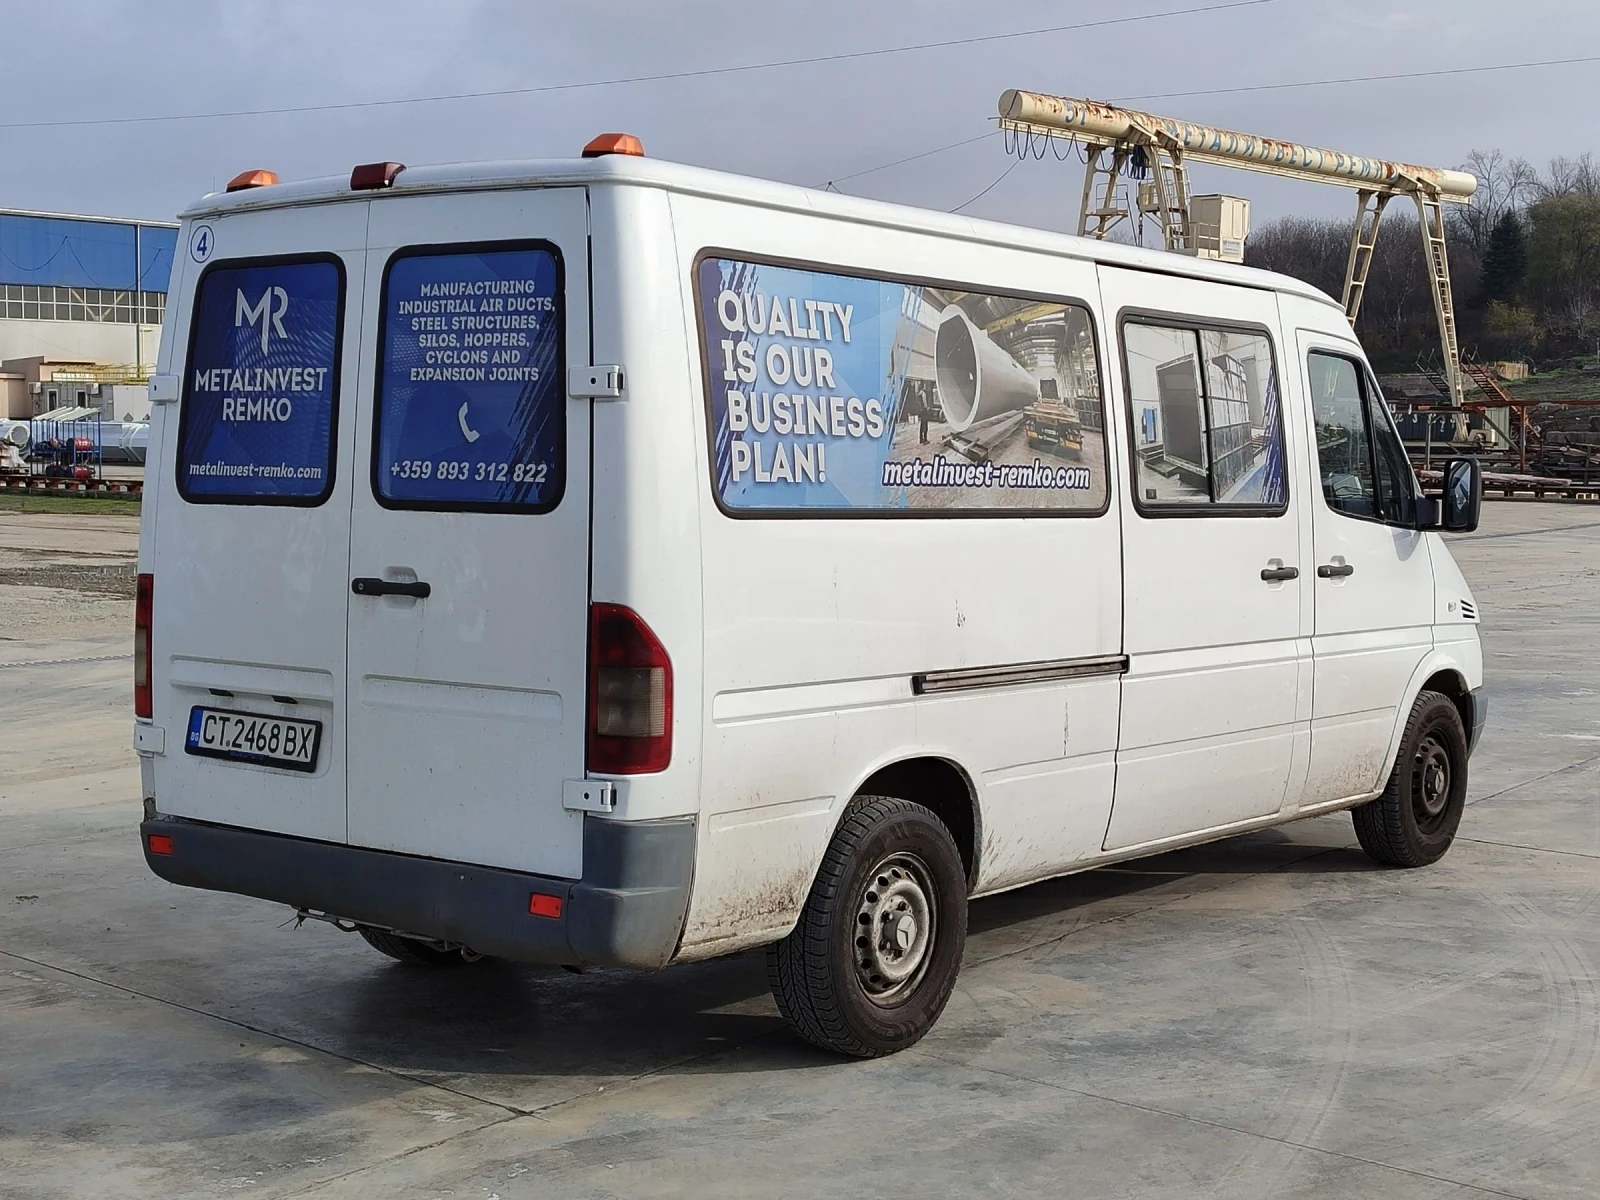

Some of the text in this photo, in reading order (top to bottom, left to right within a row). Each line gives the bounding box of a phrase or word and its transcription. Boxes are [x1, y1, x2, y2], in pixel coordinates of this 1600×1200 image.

[196, 231, 208, 256] 4
[420, 280, 535, 297] MANUFACTURING
[399, 297, 555, 314] INDUSTRIAL AIR DUCTS,
[717, 289, 854, 342] QUALITY
[411, 315, 540, 331] STEEL STRUCTURES,
[418, 332, 530, 348] SILOS, HOPPERS,
[426, 350, 520, 364] CYCLONS AND
[721, 339, 837, 388] IS OUR
[195, 367, 327, 392] METALINVEST
[410, 367, 539, 381] EXPANSION JOINTS
[222, 397, 292, 422] REMKO
[727, 389, 884, 438] BUSINESS
[189, 461, 321, 479] metalinvest-remko.com
[391, 461, 547, 483] +359 893 312 822
[730, 440, 827, 483] PLAN!
[882, 455, 1090, 488] metalinvest-remko.com
[190, 732, 199, 742] BG
